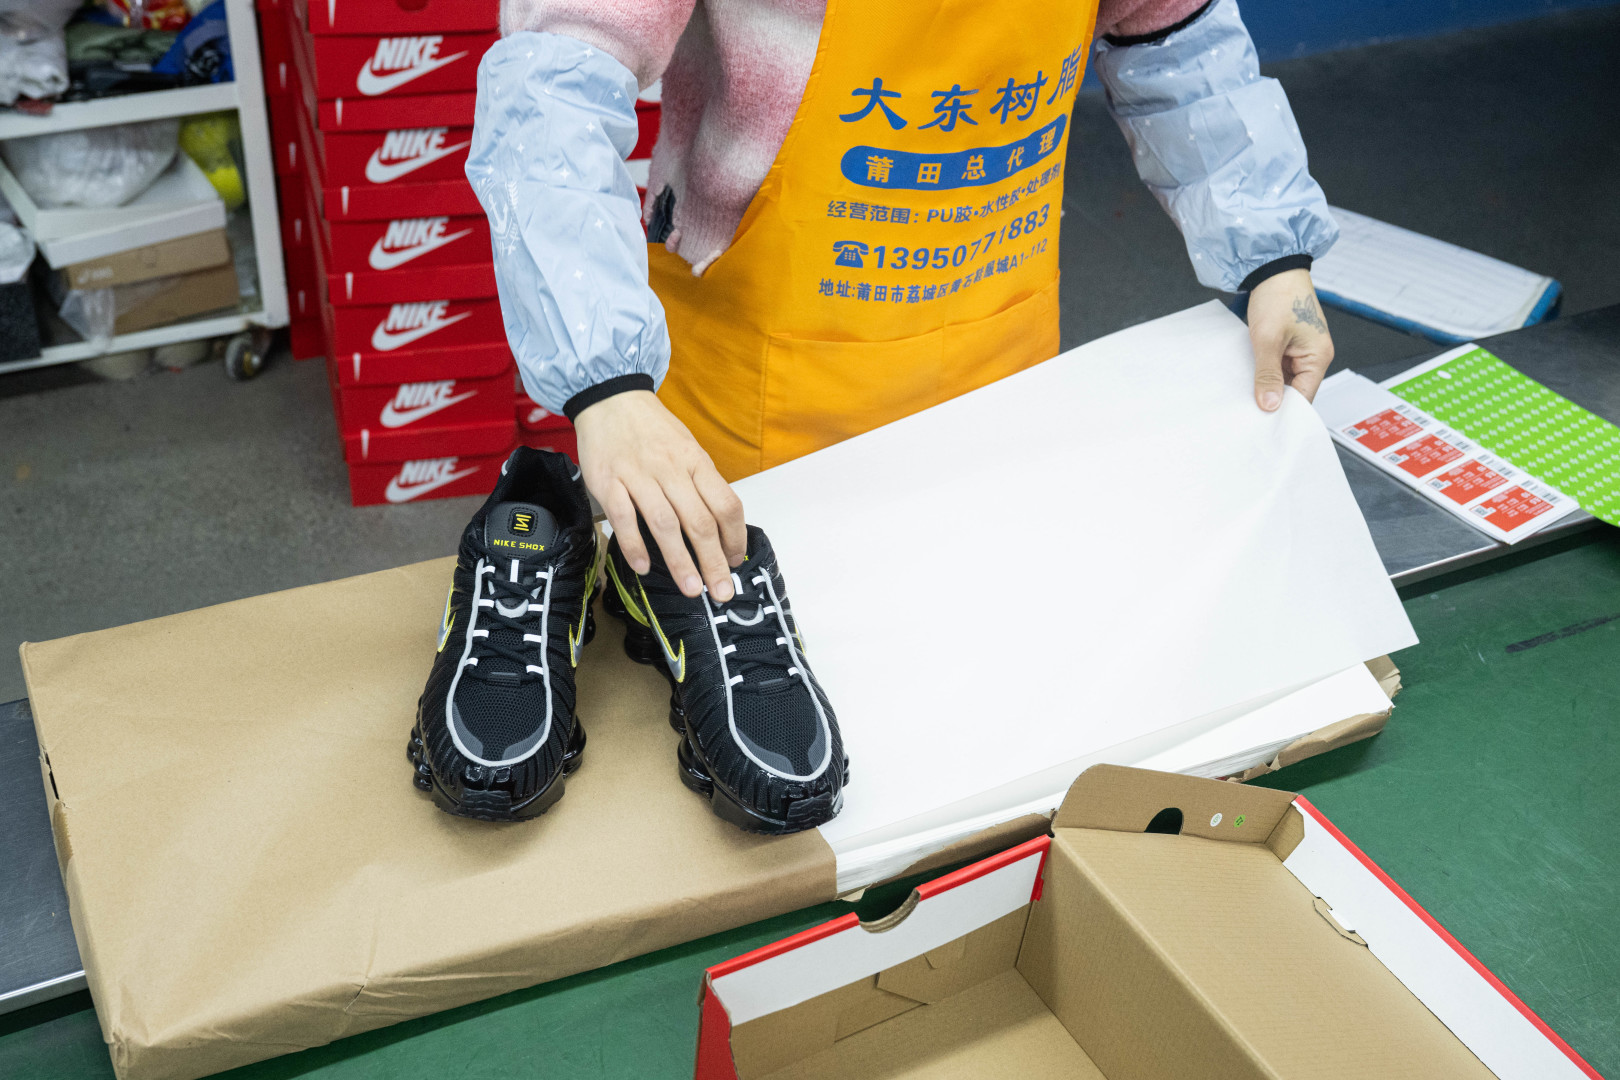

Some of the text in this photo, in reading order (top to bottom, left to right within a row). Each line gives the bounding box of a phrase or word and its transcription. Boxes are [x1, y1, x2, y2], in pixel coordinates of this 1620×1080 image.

[372, 36, 443, 71] NIKE
[839, 43, 1082, 132] 大东树脂
[380, 128, 449, 161] NIKE
[866, 126, 1056, 184] 莆田总代理
[384, 217, 449, 249] NIKE
[872, 203, 1050, 270] 13950771883
[386, 300, 449, 331] NIKE
[394, 381, 456, 409] NIKE
[399, 458, 458, 485] NIKE
[493, 539, 545, 551] NIKE SHOX
